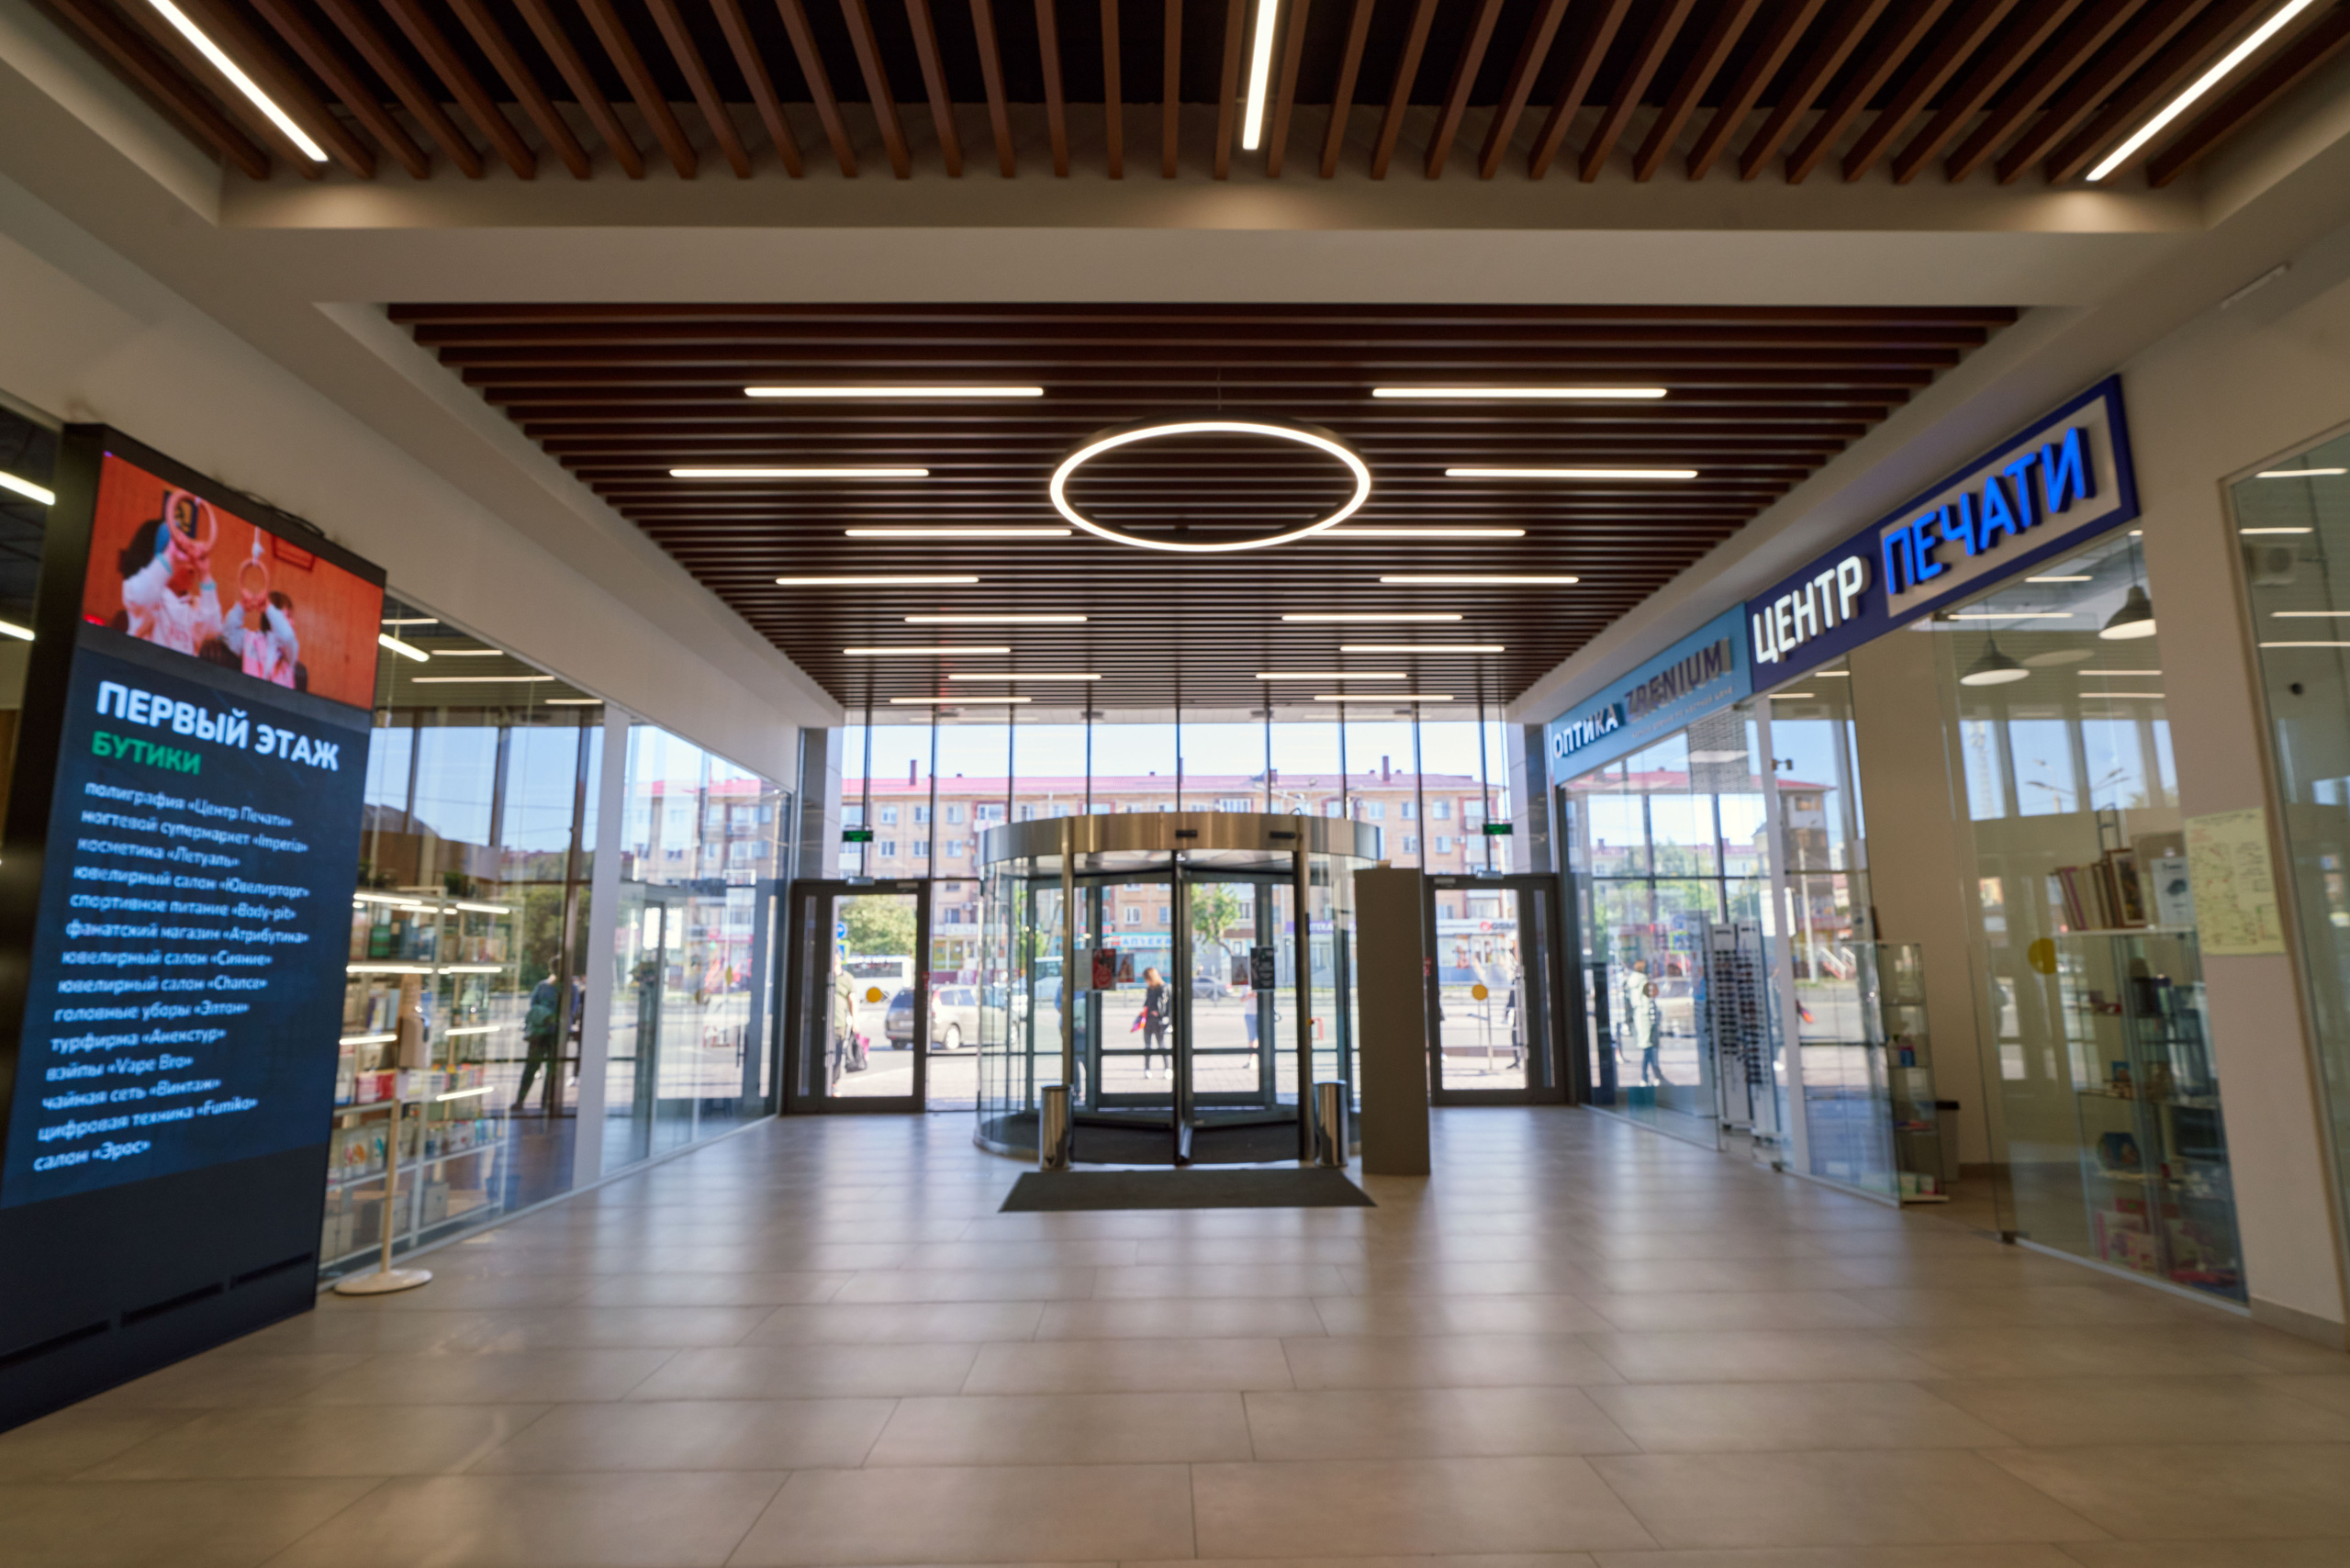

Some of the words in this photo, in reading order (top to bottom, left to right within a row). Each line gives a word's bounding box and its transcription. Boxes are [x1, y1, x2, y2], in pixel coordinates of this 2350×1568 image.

[1752, 555, 1863, 665] ЦЕНТР
[1884, 427, 2086, 595] ПЕЧАТИ
[1553, 703, 1618, 759] ОПТИКА
[1625, 639, 1725, 718] ZRENIUM
[95, 680, 251, 750] ПЕРВЫЙ
[254, 723, 340, 772] ЭТАЖ
[92, 731, 202, 775] БУТИКИ
[85, 782, 185, 811] полиграфия
[82, 811, 158, 832] ногтевой
[161, 822, 251, 845] супермаркет
[78, 838, 164, 859] косметика
[74, 866, 172, 887] ювелирный
[173, 875, 217, 890] салон
[70, 894, 168, 913] спортивное
[170, 901, 229, 917] питание
[66, 918, 158, 939] фанатский
[161, 927, 221, 940] магазин
[62, 949, 162, 968] ювелирный
[164, 953, 208, 966] салон
[58, 976, 159, 995] ювелирный
[161, 979, 206, 991] салон
[54, 1006, 140, 1022] головные
[142, 1002, 191, 1021] уборы
[50, 1032, 140, 1055] турфирма
[47, 1062, 104, 1081] вэйпы
[42, 1091, 107, 1110] чайная
[110, 1087, 148, 1103] сеть
[38, 1115, 129, 1143] цифровая
[132, 1106, 195, 1126] техника
[34, 1150, 89, 1171] салон
